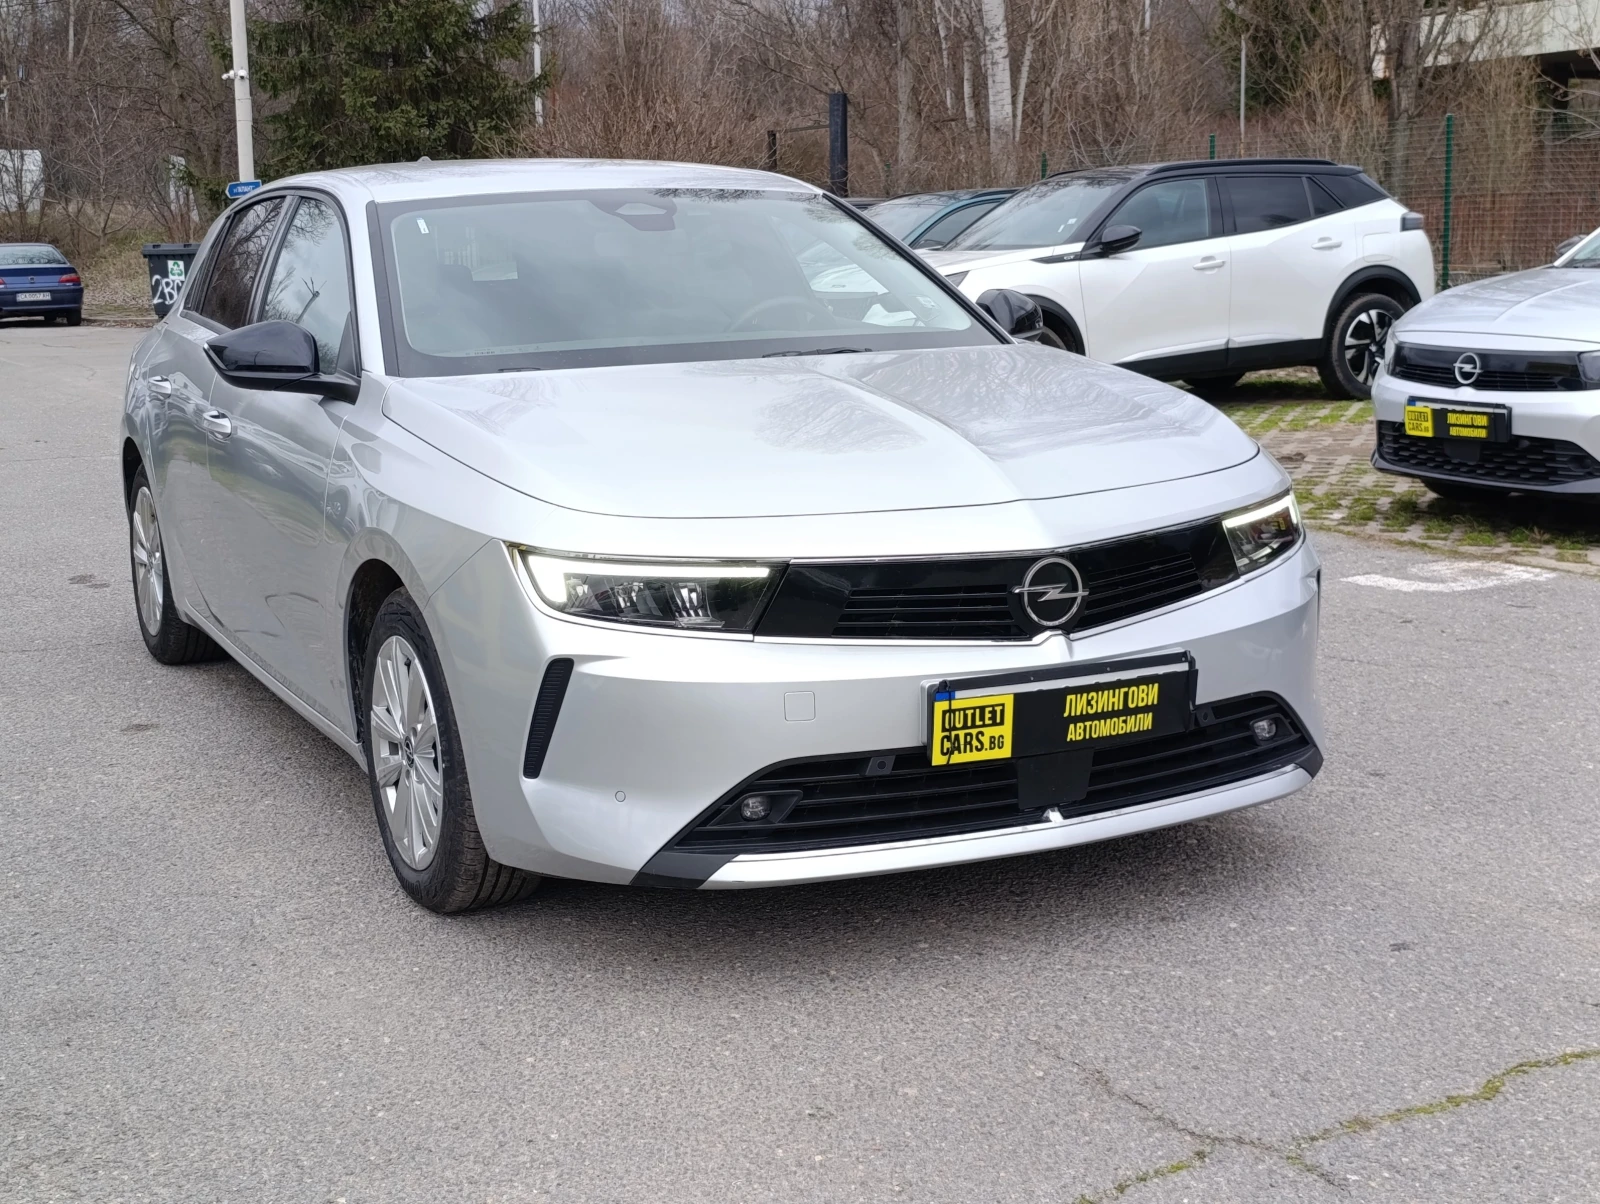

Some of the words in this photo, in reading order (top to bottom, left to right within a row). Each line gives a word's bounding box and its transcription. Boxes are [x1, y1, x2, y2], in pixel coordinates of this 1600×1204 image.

[1408, 411, 1428, 422] OUTLET
[1447, 412, 1488, 426] ЛИЗИНГОВИ
[1408, 422, 1430, 433] CARS.BG
[1449, 426, 1487, 438] АВТОМОБИЛИ
[1063, 683, 1159, 717] ЛИЗИНГОВИ
[944, 705, 1003, 729] OUTLET
[1067, 712, 1153, 742] АВТОМОБИЛИ
[940, 731, 1004, 757] CARS.BG
